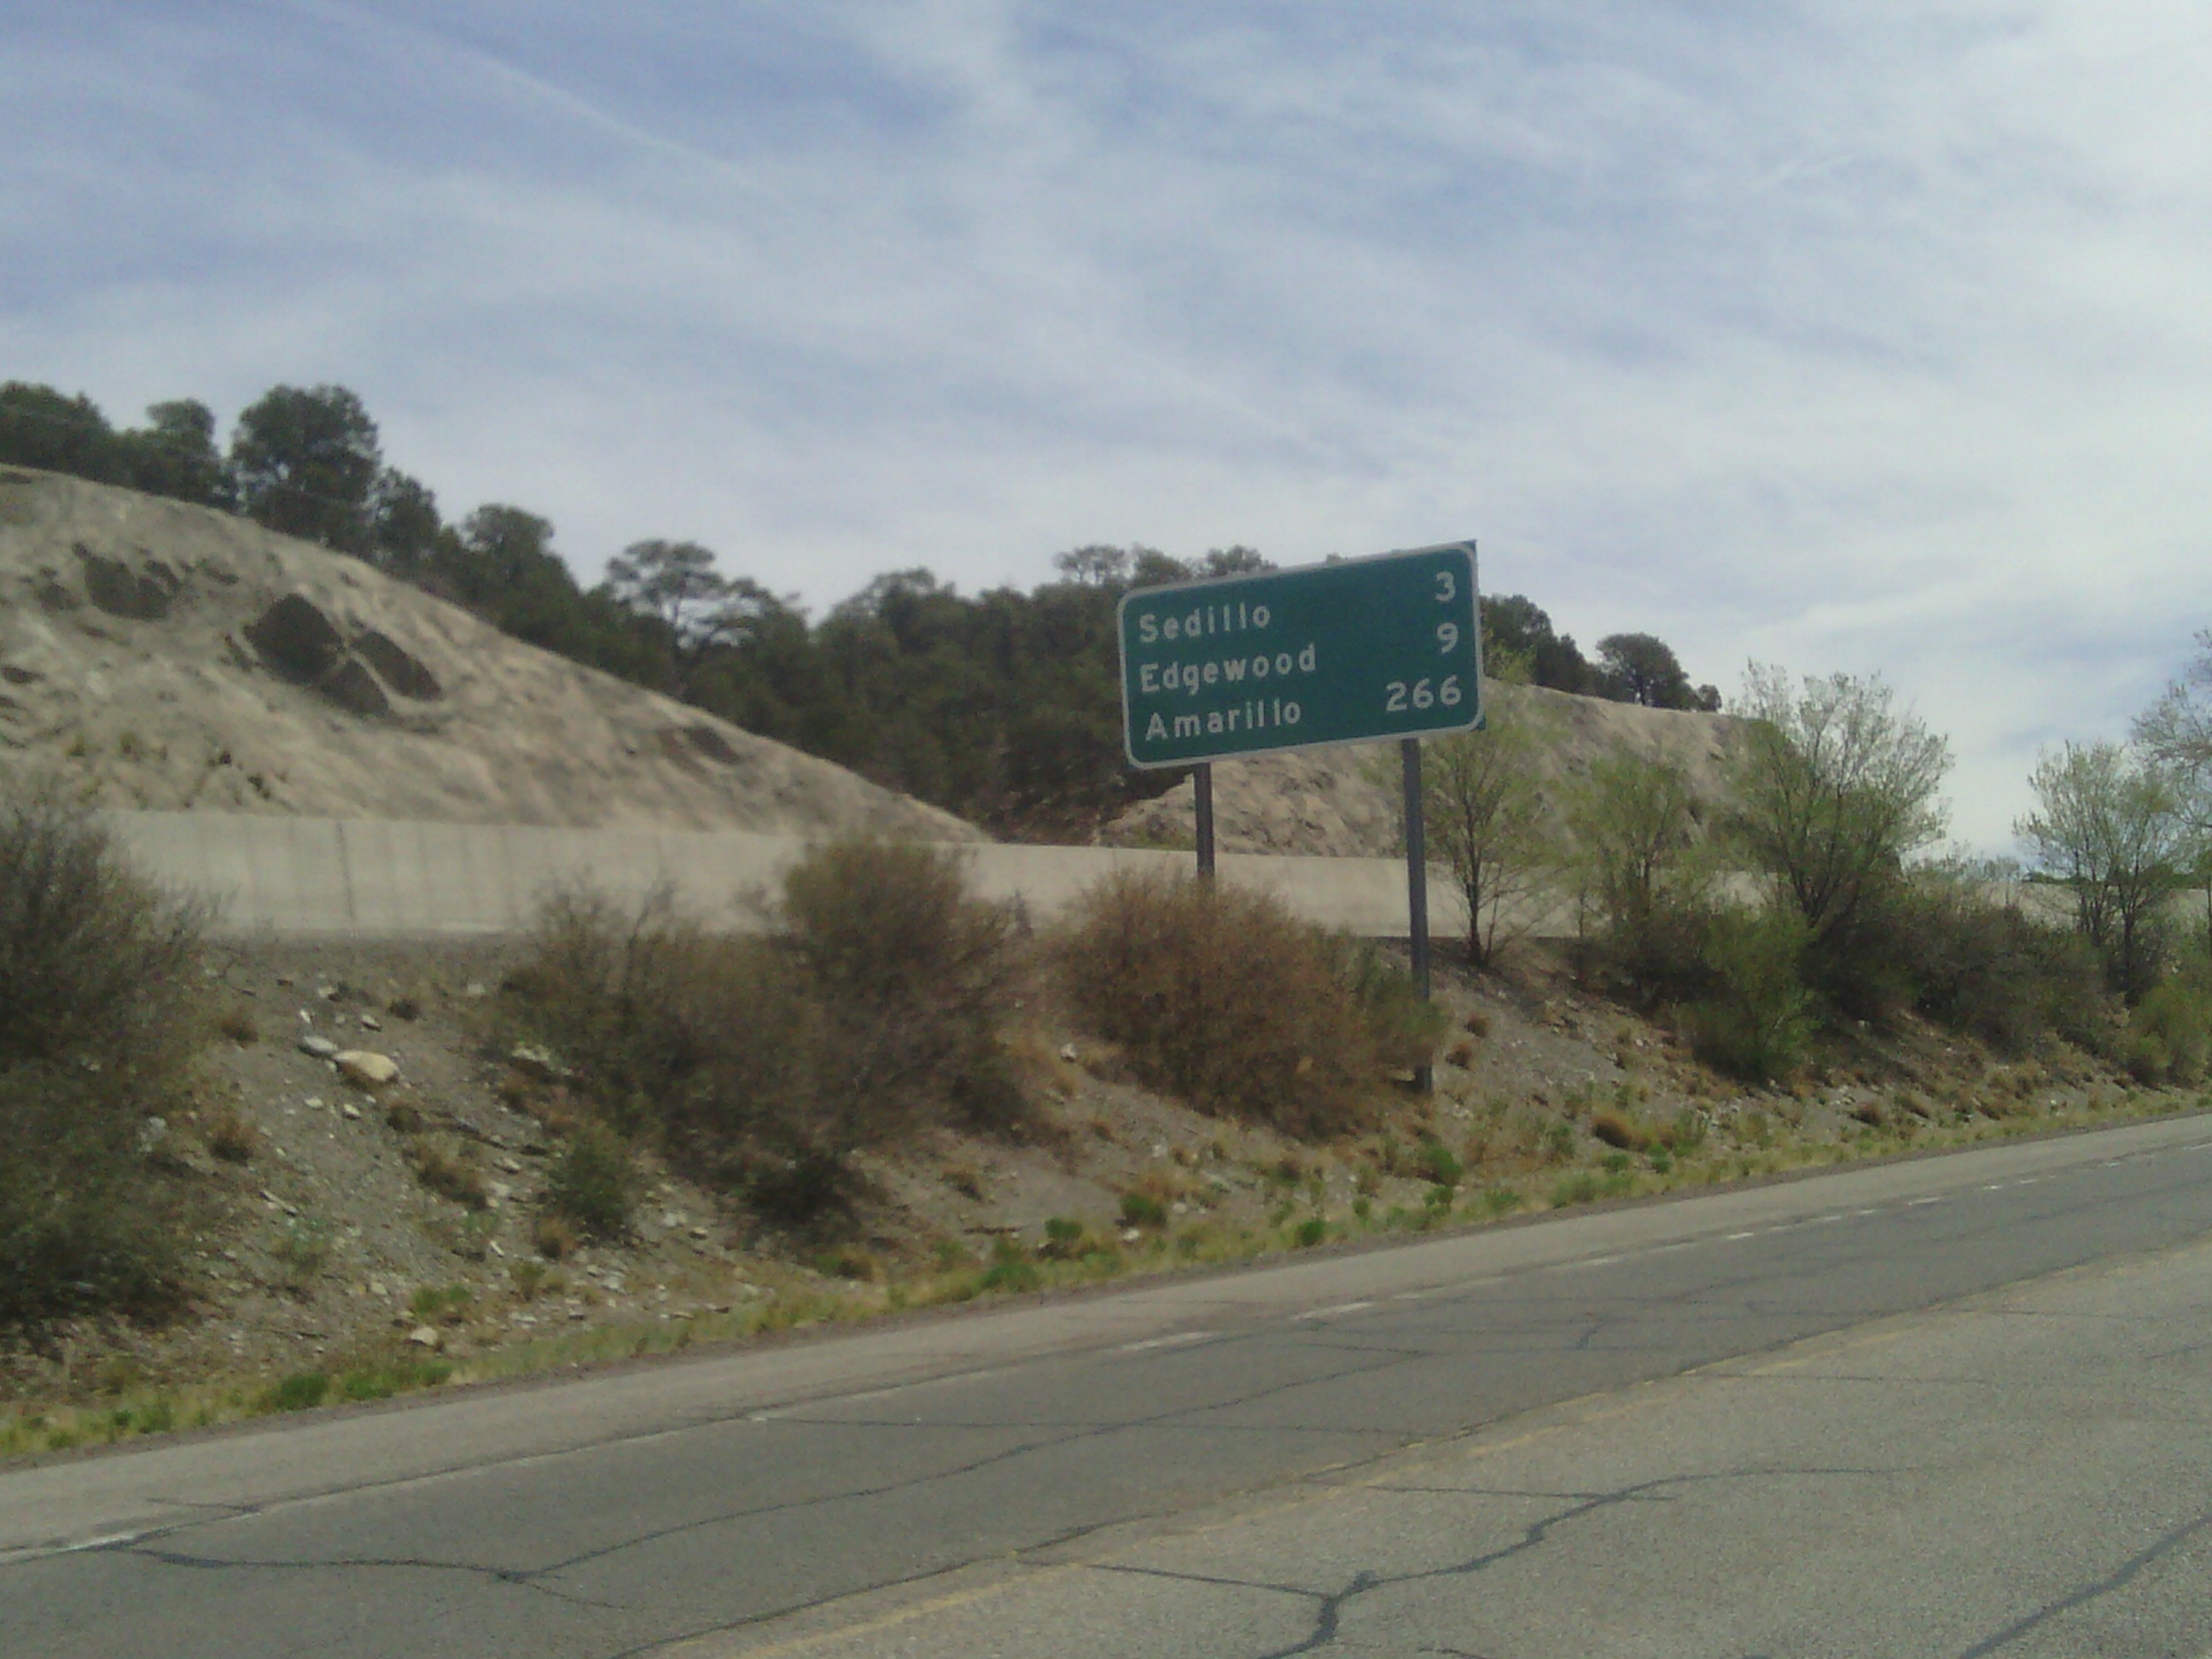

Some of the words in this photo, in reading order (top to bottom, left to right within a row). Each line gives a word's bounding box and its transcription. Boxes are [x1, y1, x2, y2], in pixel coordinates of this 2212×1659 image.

[1139, 602, 1271, 643] Sedillo
[1435, 571, 1457, 602] 3
[1140, 642, 1317, 696] Edgewood
[1435, 622, 1459, 654] 9
[1145, 697, 1301, 742] Amarillo
[1385, 674, 1462, 712] 266
